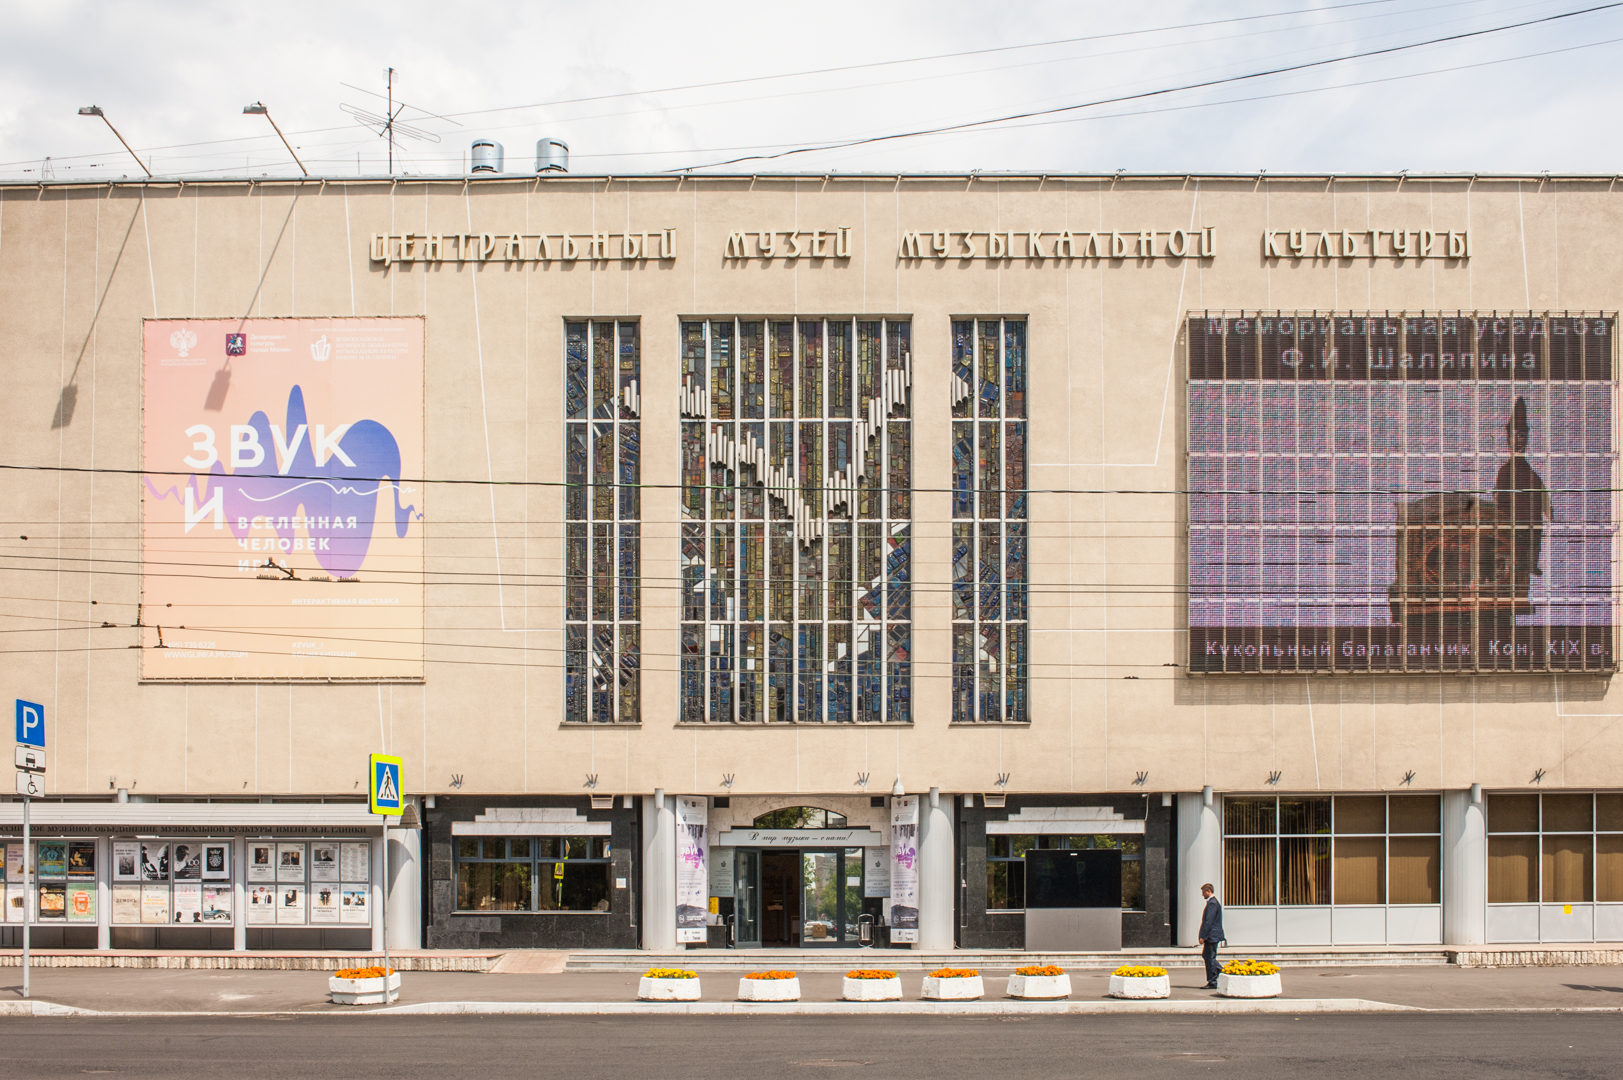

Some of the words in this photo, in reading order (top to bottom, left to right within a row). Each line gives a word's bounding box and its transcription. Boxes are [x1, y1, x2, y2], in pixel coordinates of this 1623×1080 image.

[369, 227, 678, 266] ЦЕНТРАЛЬНЫЙ
[723, 226, 852, 260] МУЗЕЙ
[898, 226, 1217, 260] МУЗЫКАЛЬНОЙ
[1263, 228, 1472, 260] КУЛЬТУРЫ
[1207, 317, 1458, 340] Мемориальная
[1476, 317, 1607, 340] усадьба
[1368, 348, 1537, 369] Шаляпина
[183, 423, 357, 475] ЗВУК
[184, 486, 224, 534] И
[237, 516, 358, 530] ВСЕЛЕННАЯ
[237, 537, 331, 551] ЧЕЛОВЕК
[1205, 640, 1332, 656] Кукольный
[1546, 640, 1581, 656] XIX
[23, 706, 39, 739] P
